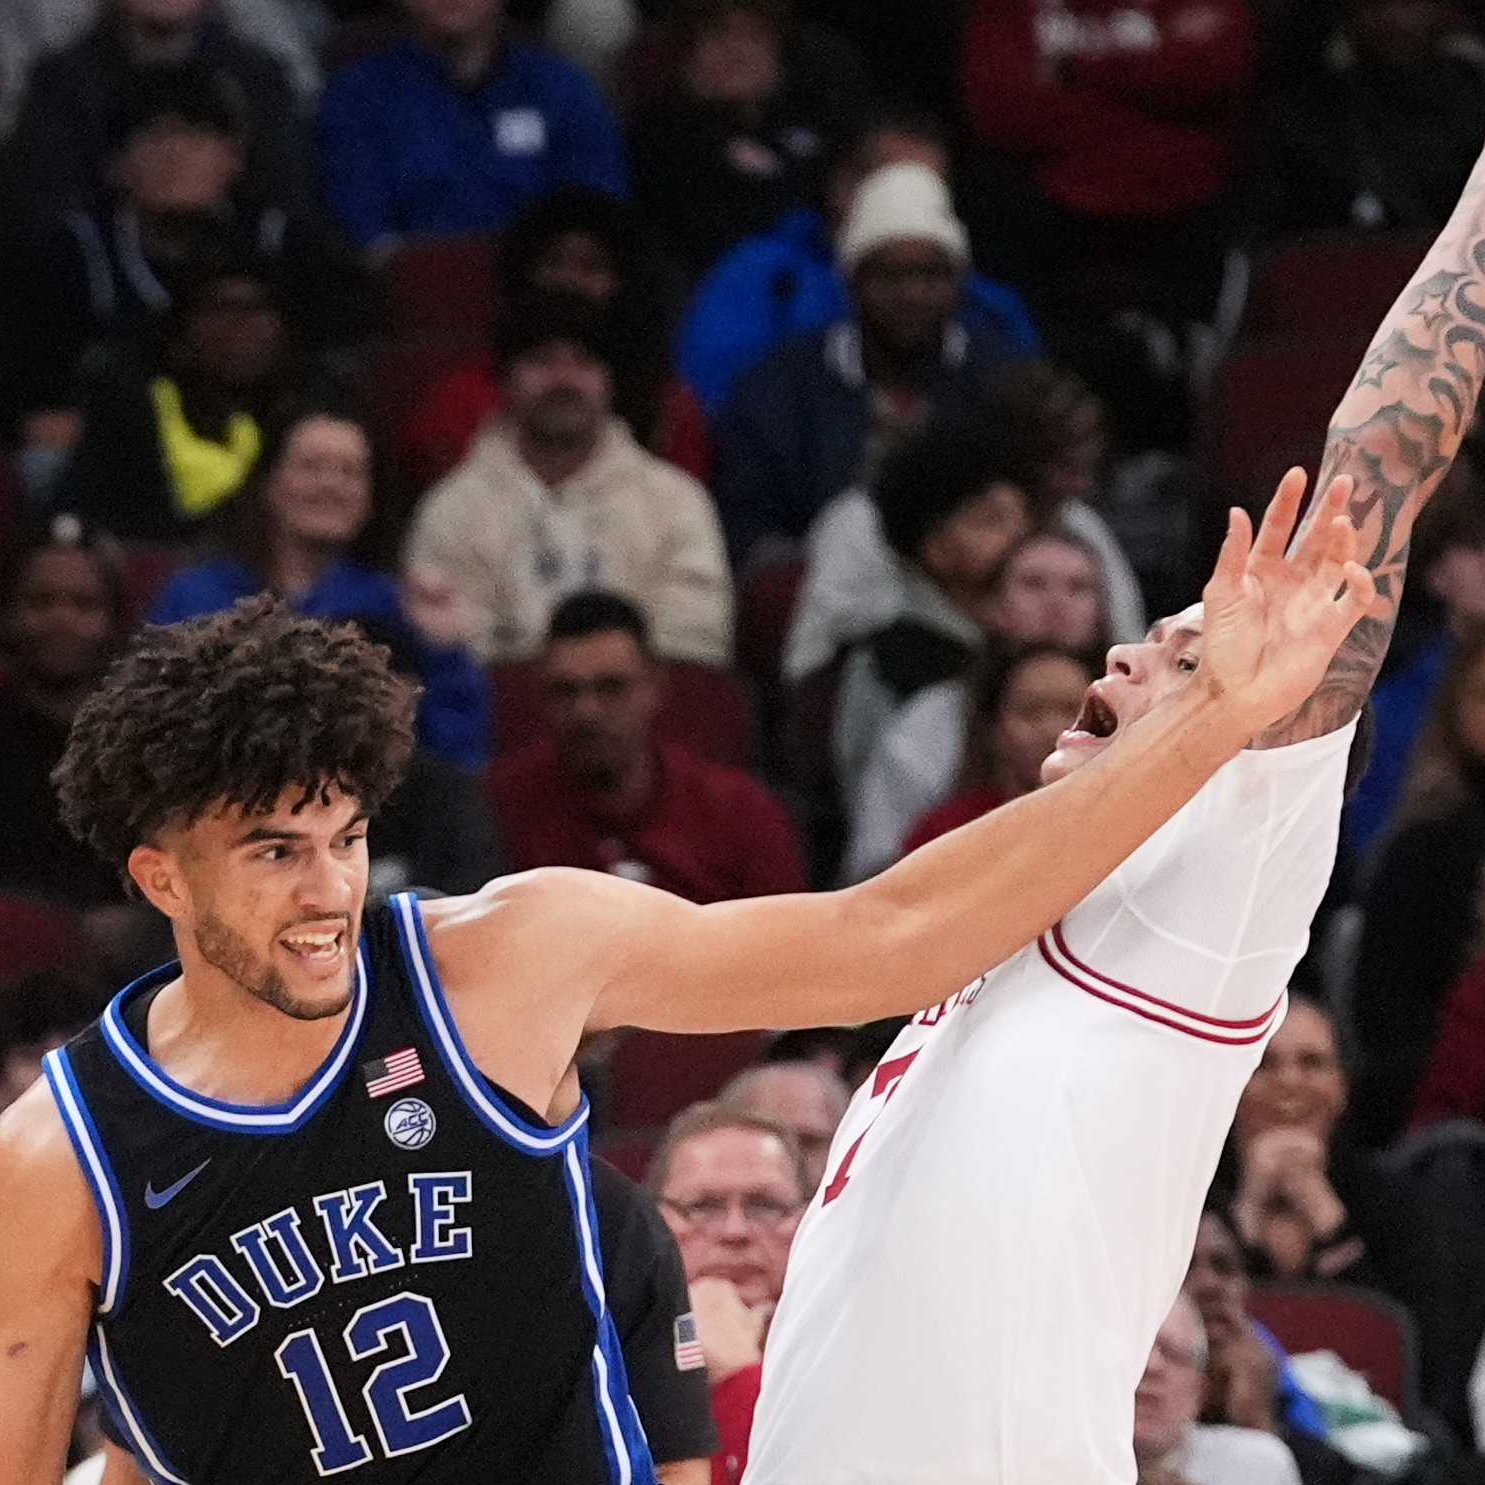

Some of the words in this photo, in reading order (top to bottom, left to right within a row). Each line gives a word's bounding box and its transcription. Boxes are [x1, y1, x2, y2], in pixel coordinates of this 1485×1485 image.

[396, 1110, 429, 1130] ACC
[162, 1170, 472, 1348] DUKE
[274, 1291, 472, 1476] 12
